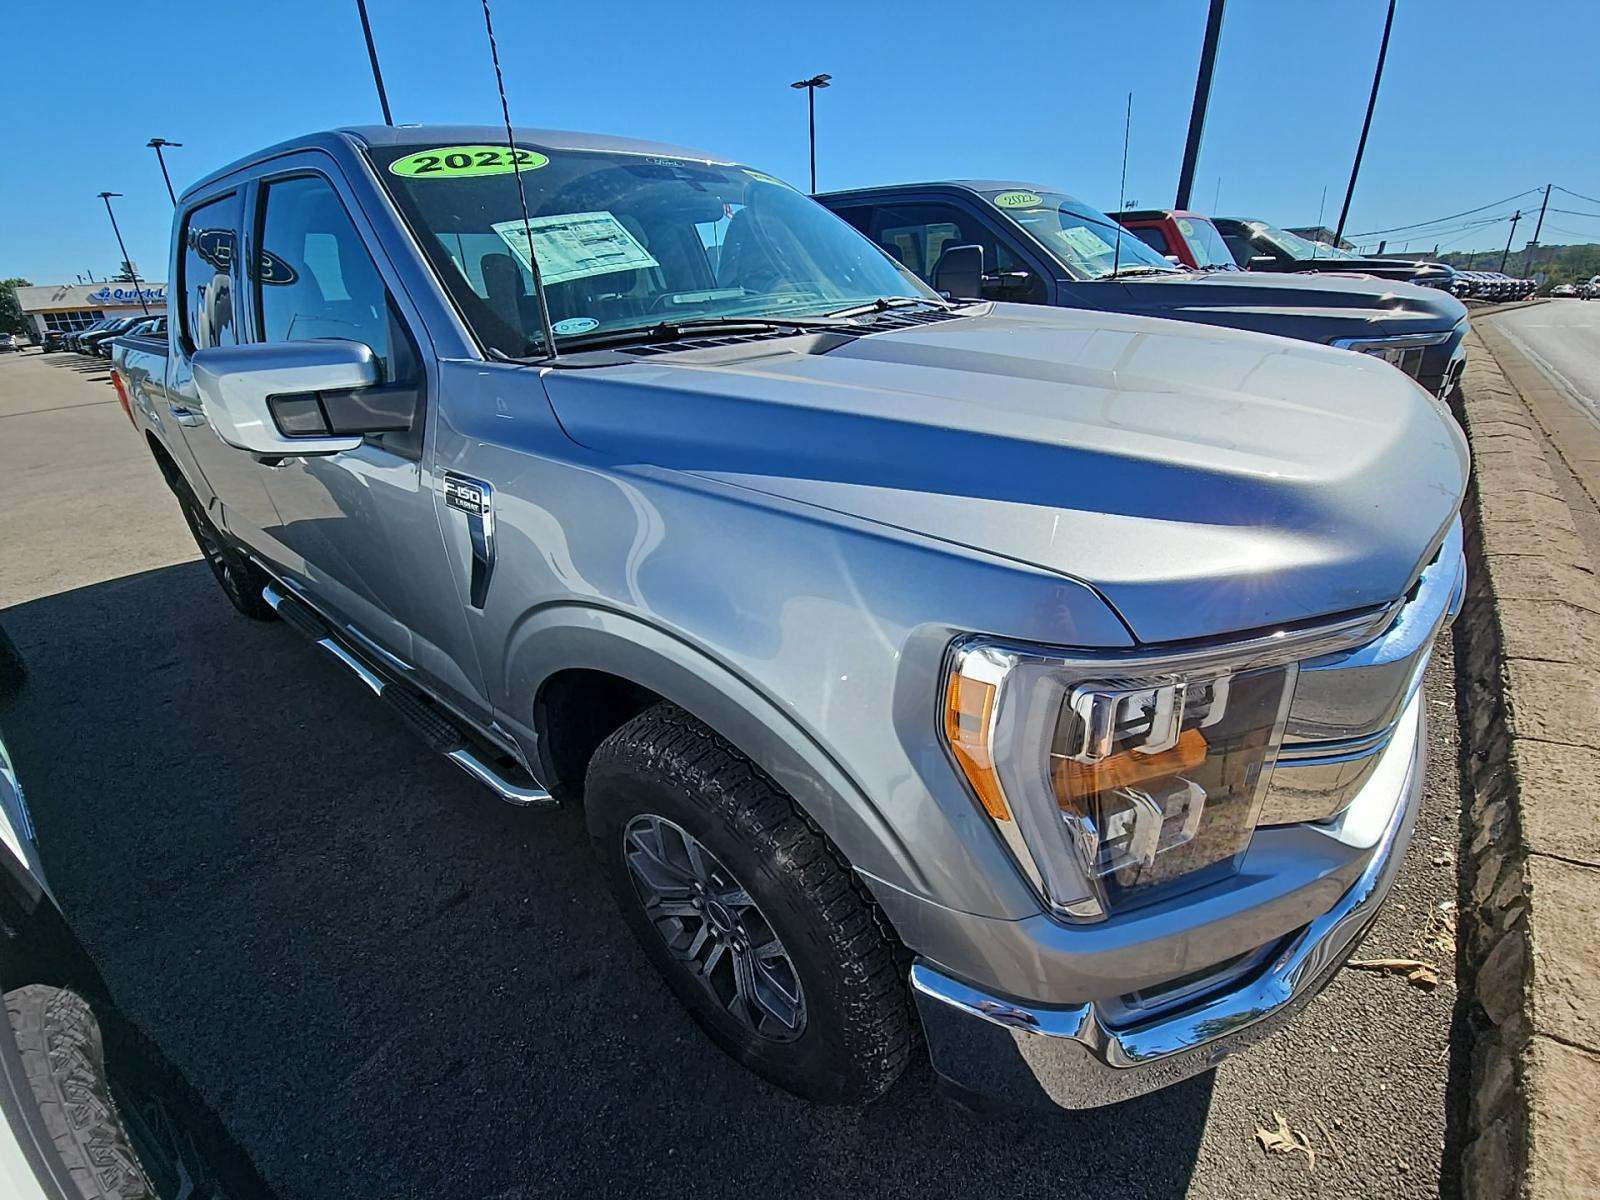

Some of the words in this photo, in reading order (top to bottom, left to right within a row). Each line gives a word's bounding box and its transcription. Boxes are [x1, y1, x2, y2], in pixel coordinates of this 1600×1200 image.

[413, 152, 535, 174] 2022
[1003, 194, 1036, 205] 2022
[444, 482, 480, 504] F-150
